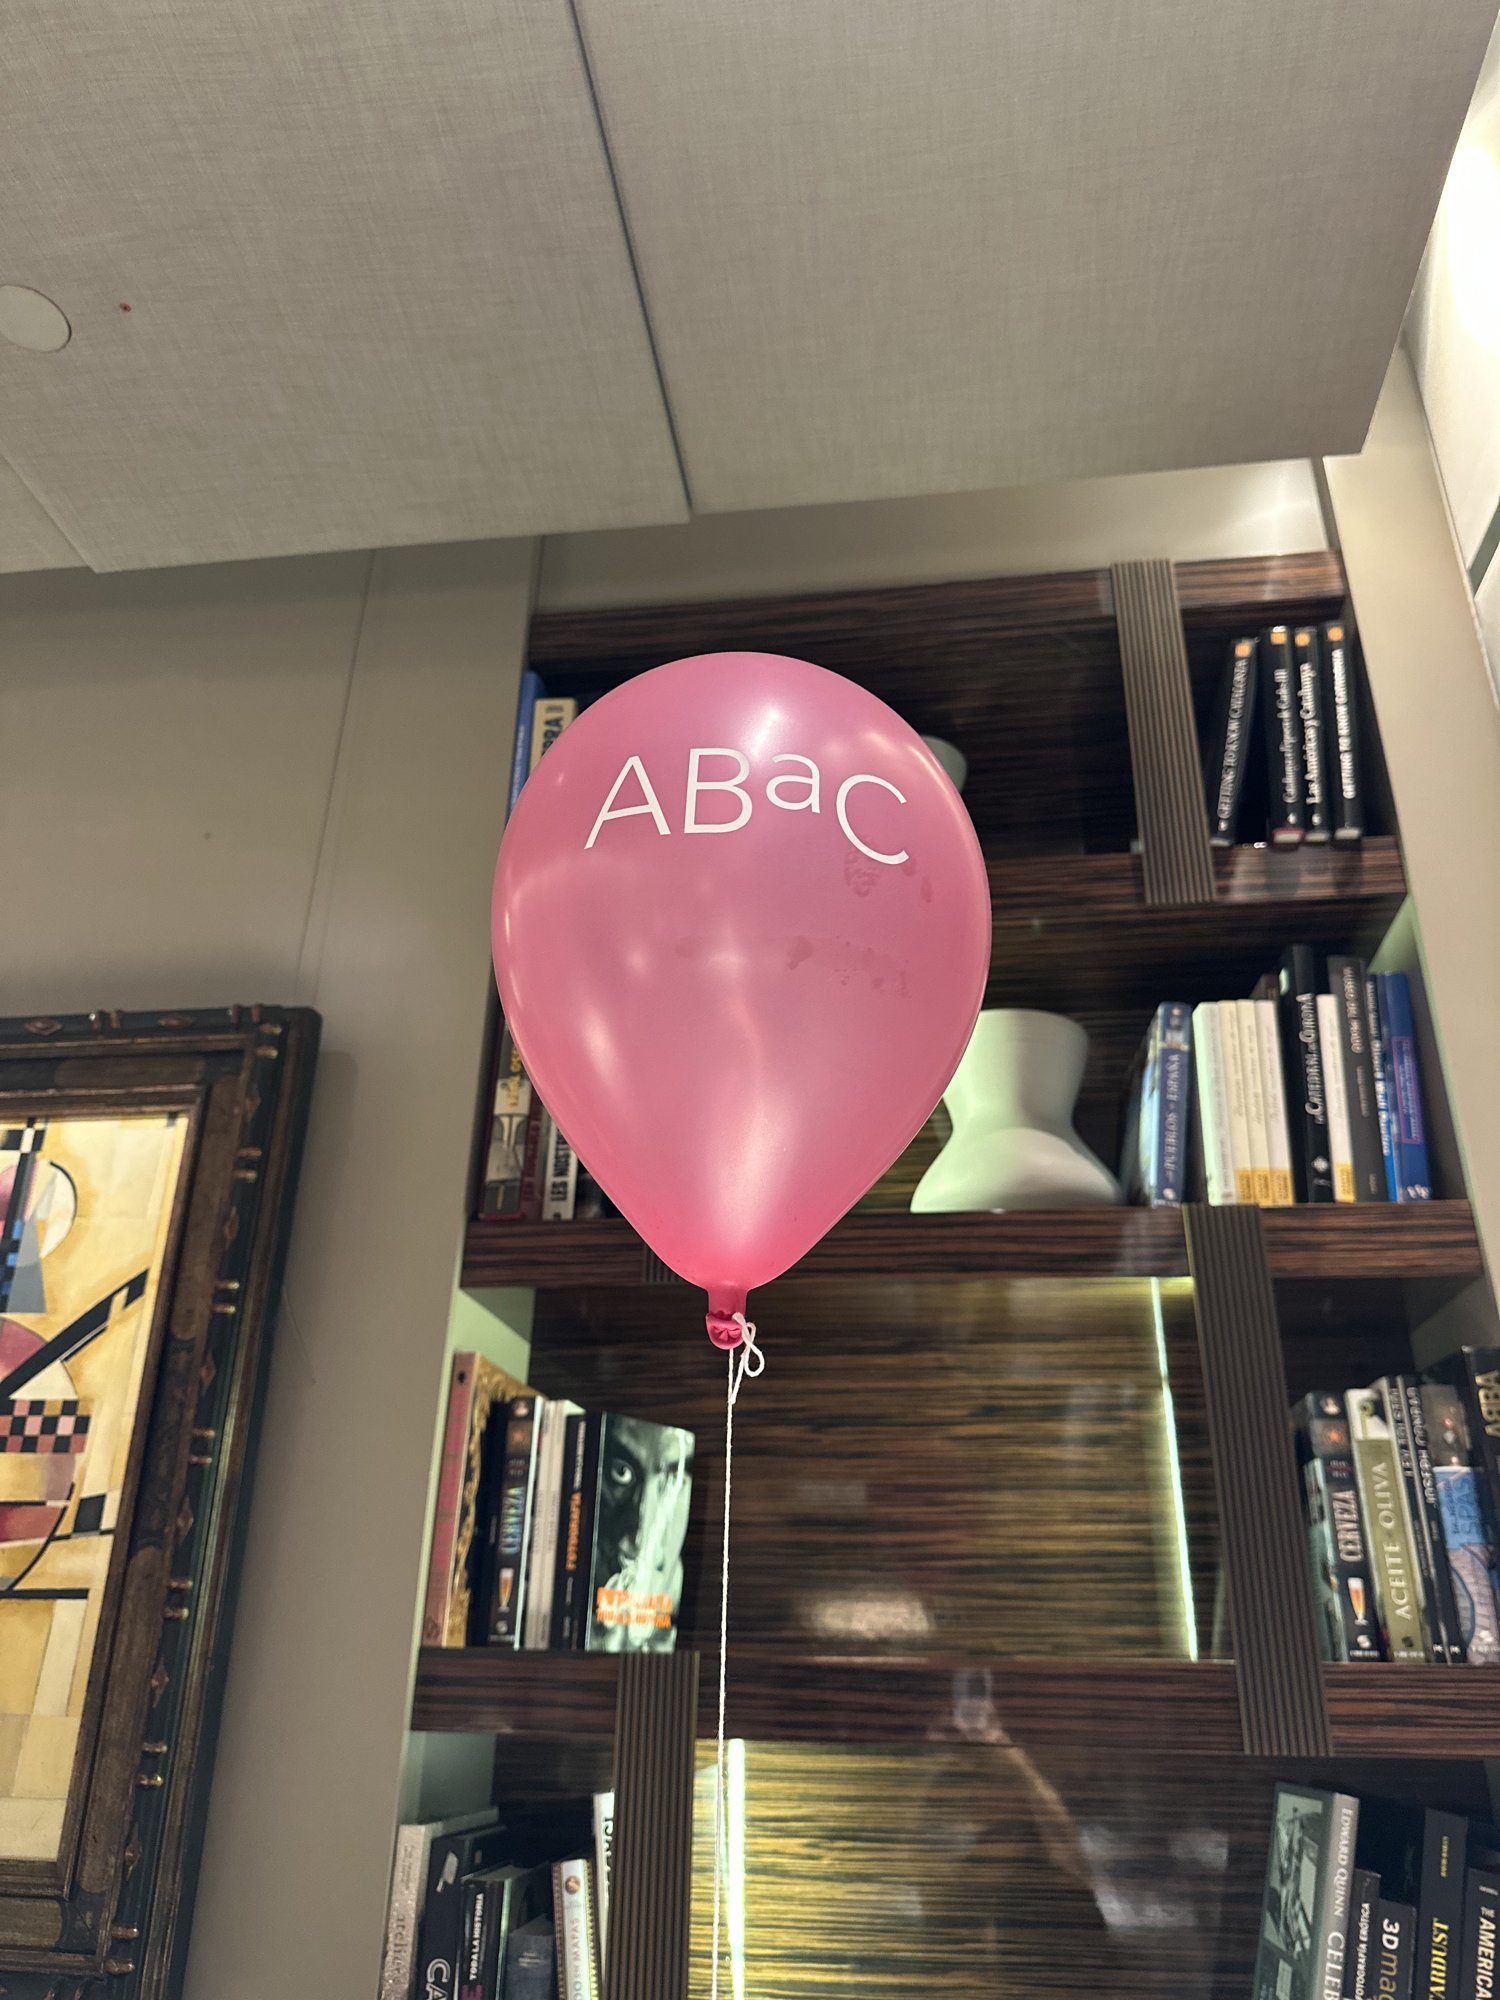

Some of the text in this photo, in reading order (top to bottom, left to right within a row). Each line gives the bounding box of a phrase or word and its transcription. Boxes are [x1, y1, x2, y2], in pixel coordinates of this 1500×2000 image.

[584, 747, 910, 865] ABaC
[498, 1486, 525, 1555] CERVEZA
[1332, 1489, 1364, 1562] CERVEZA
[1371, 1462, 1397, 1530] OLIVA
[1382, 1542, 1413, 1620] ACEITE
[1337, 1807, 1353, 1867] EDWARD
[472, 1892, 485, 1938] HISTORIA
[1333, 1867, 1349, 1918] QUINN
